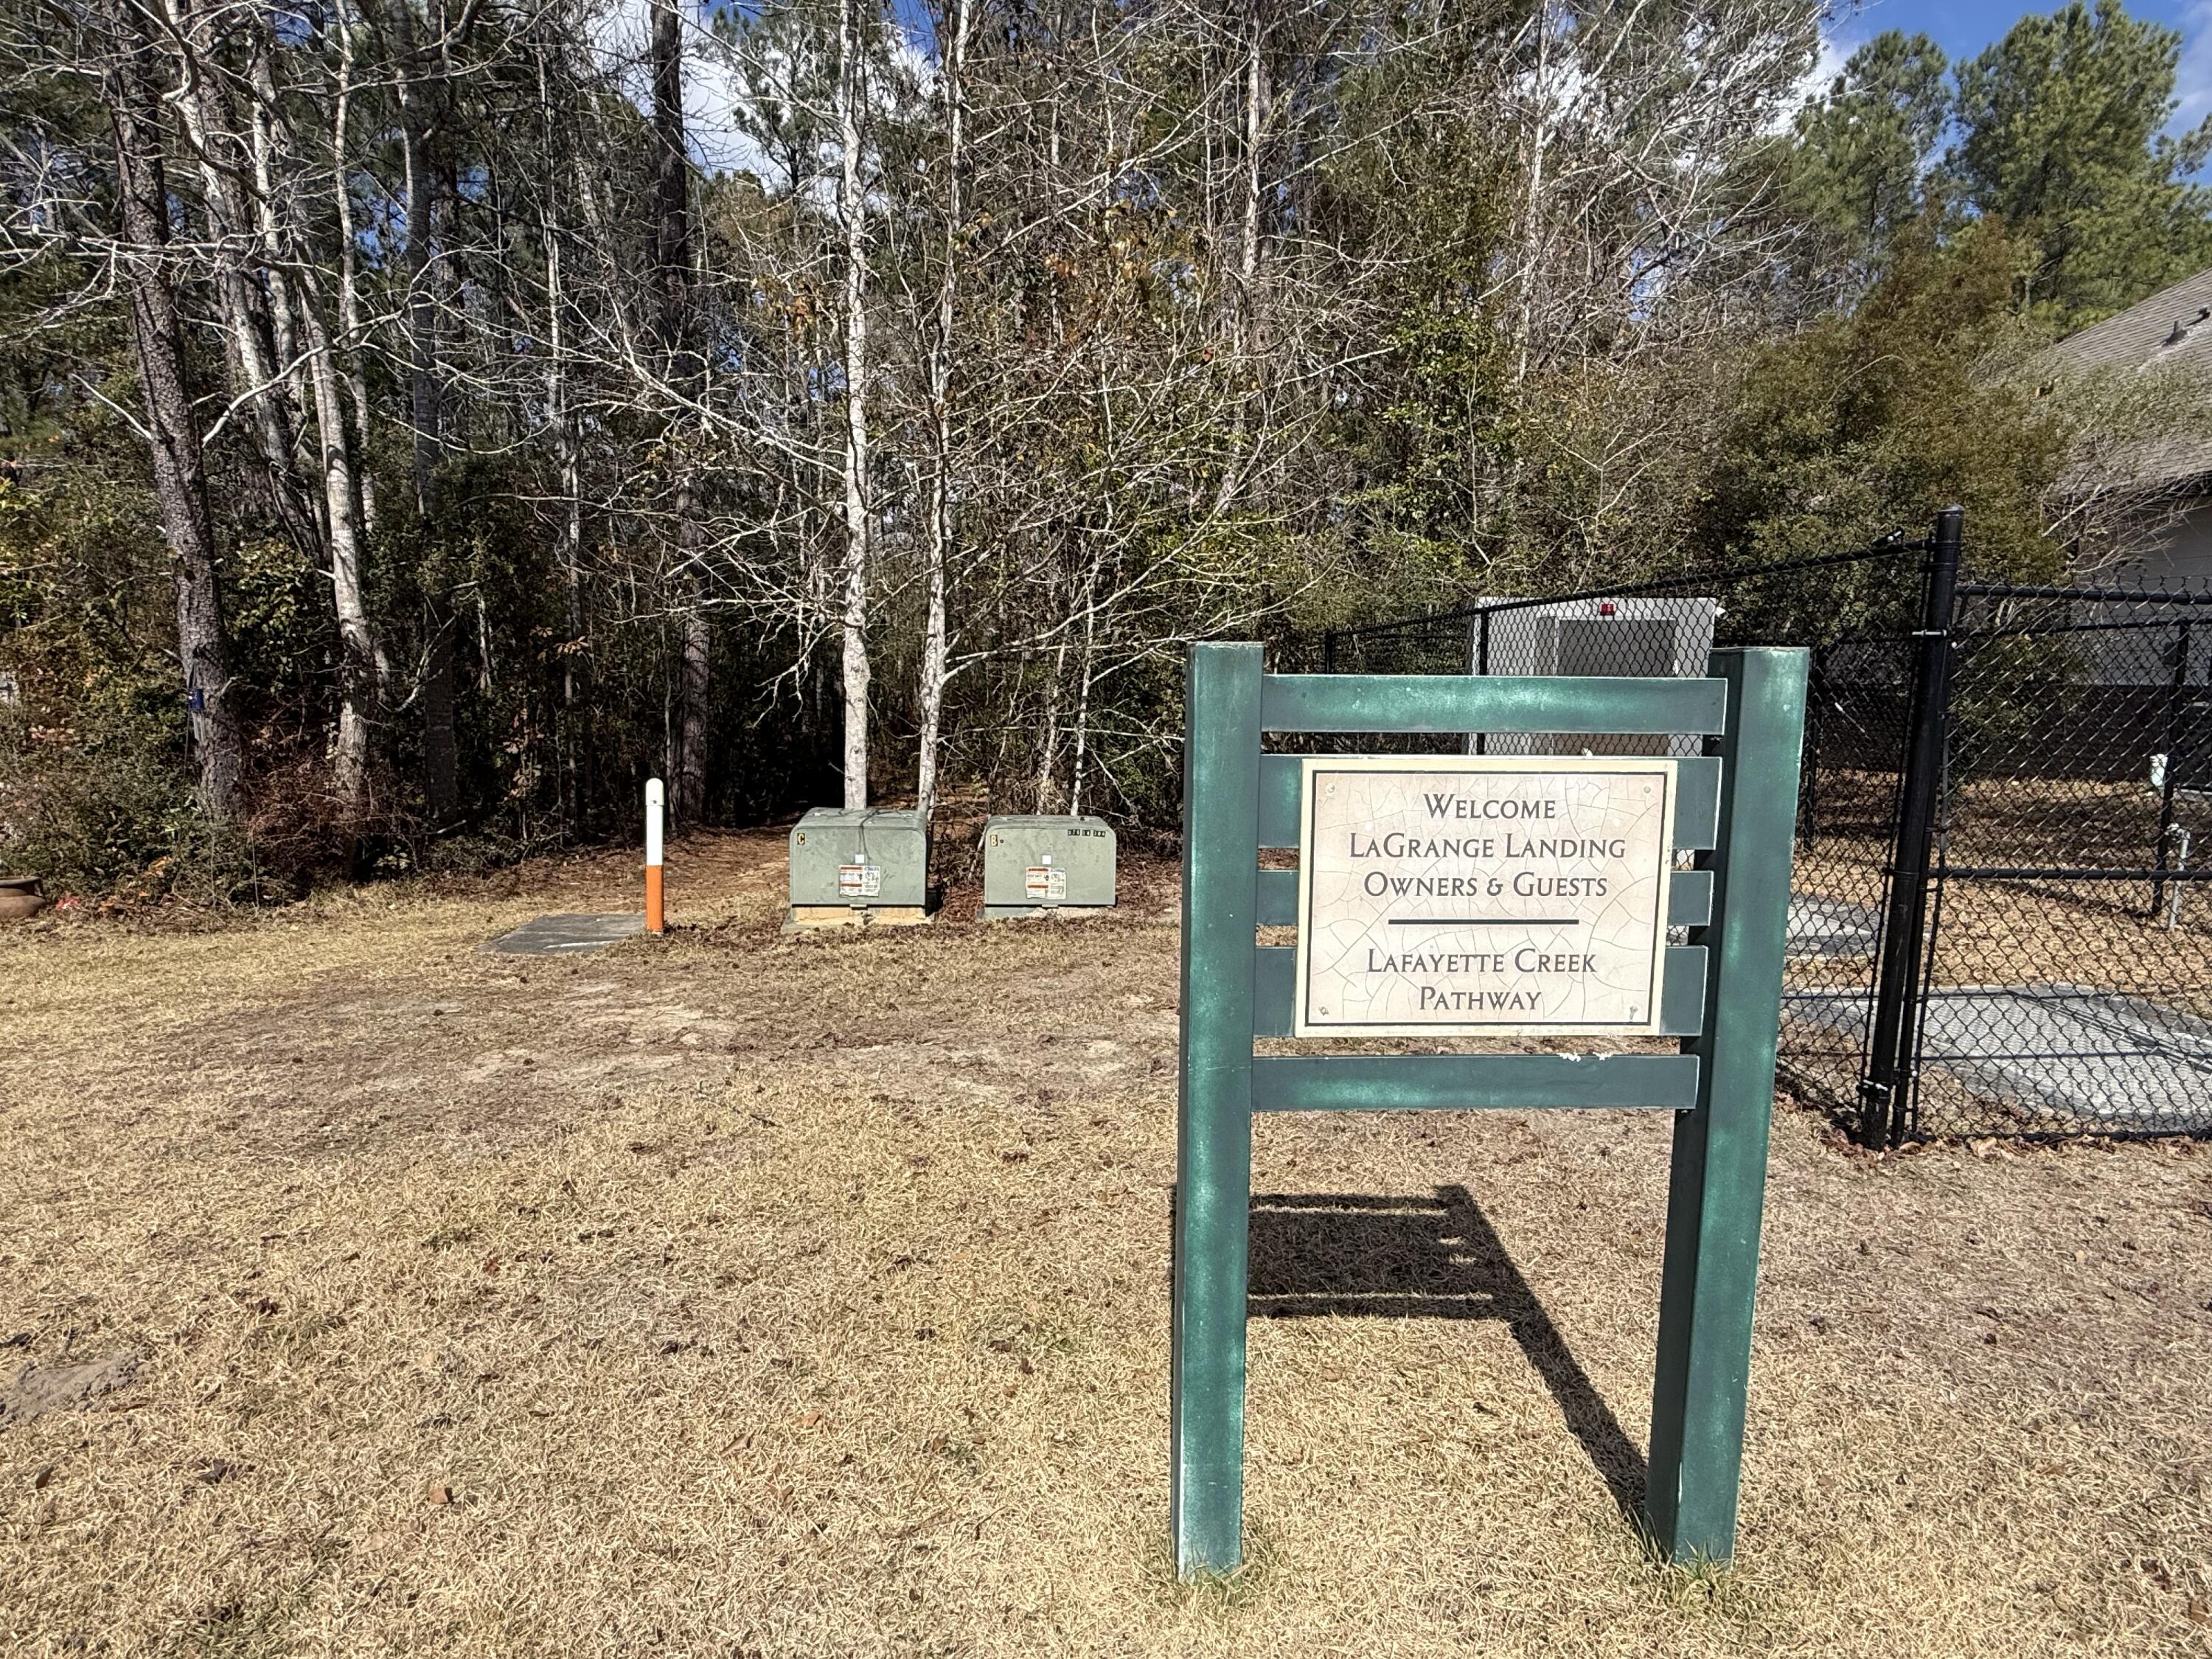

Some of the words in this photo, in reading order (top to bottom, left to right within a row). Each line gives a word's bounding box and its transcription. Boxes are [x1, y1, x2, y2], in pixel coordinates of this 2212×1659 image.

[1424, 793, 1555, 819] WELCOME
[1506, 833, 1625, 858] LANDING
[1364, 872, 1477, 897] OWNERS
[1486, 877, 1503, 897] &
[1513, 872, 1607, 897] GUESTS
[1368, 948, 1504, 973] LAFAYETTE
[1514, 948, 1596, 973] CREEK
[1420, 986, 1542, 1010] PATHWAY
